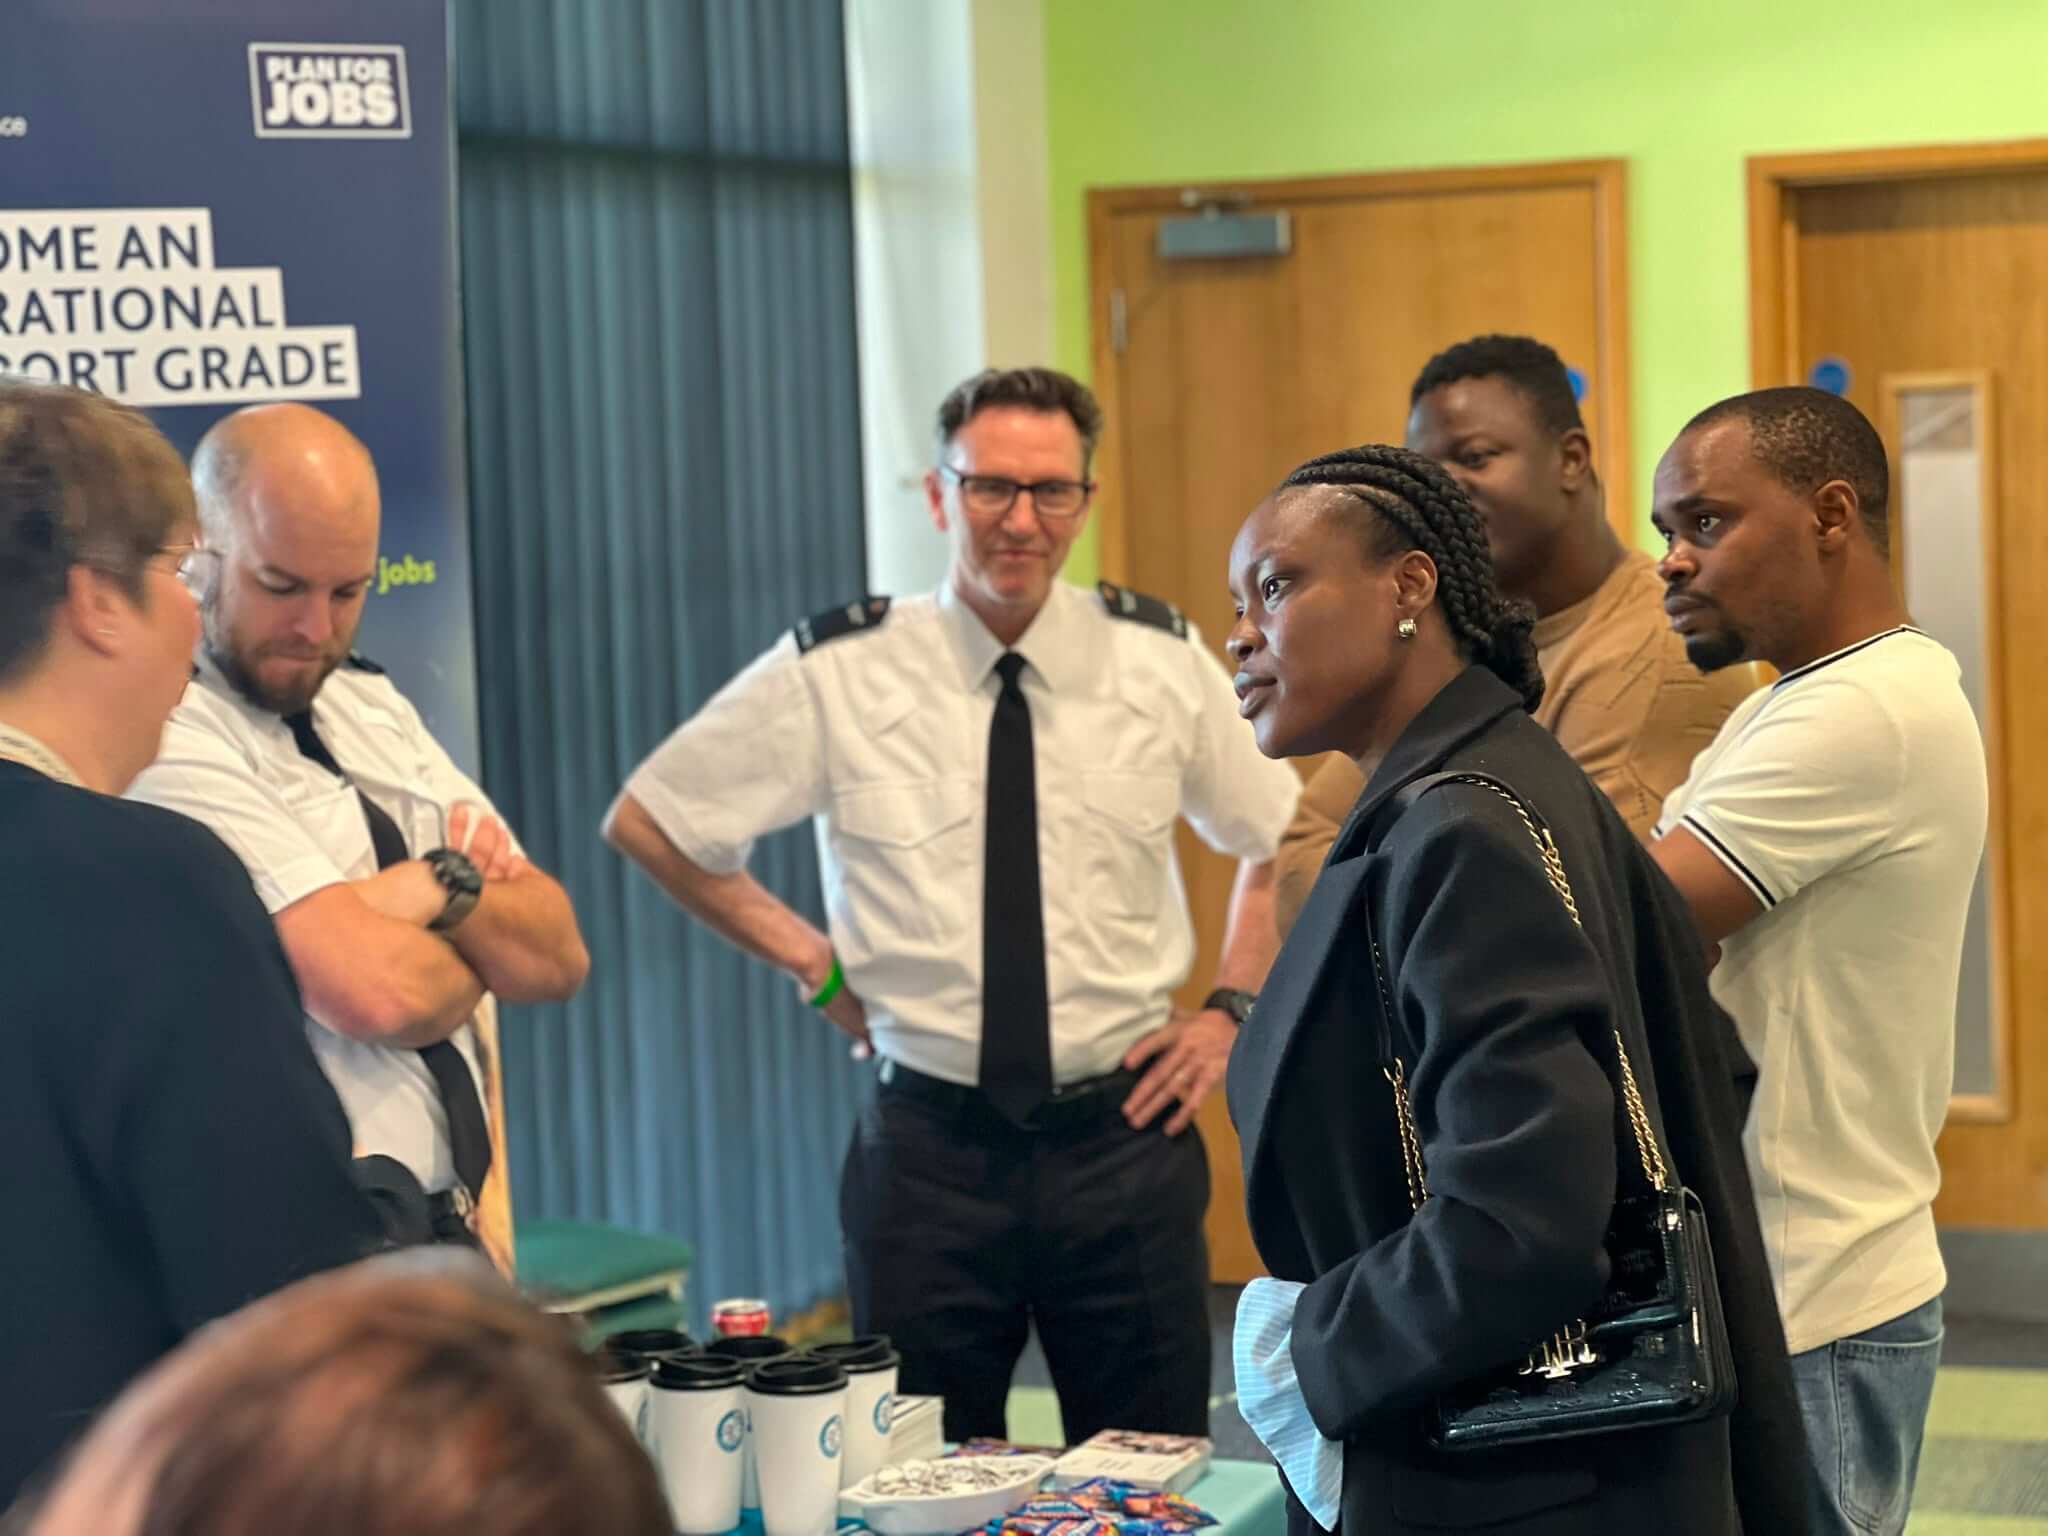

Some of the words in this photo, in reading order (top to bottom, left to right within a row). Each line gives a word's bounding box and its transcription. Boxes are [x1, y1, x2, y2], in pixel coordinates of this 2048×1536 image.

[266, 56, 337, 82] PLAN
[338, 57, 391, 84] FOR
[265, 81, 398, 126] JOBS
[0, 226, 99, 271] ME
[116, 224, 200, 271] AN
[0, 349, 136, 394] ORT
[154, 342, 347, 391] GRADE
[378, 554, 436, 595] jobs
